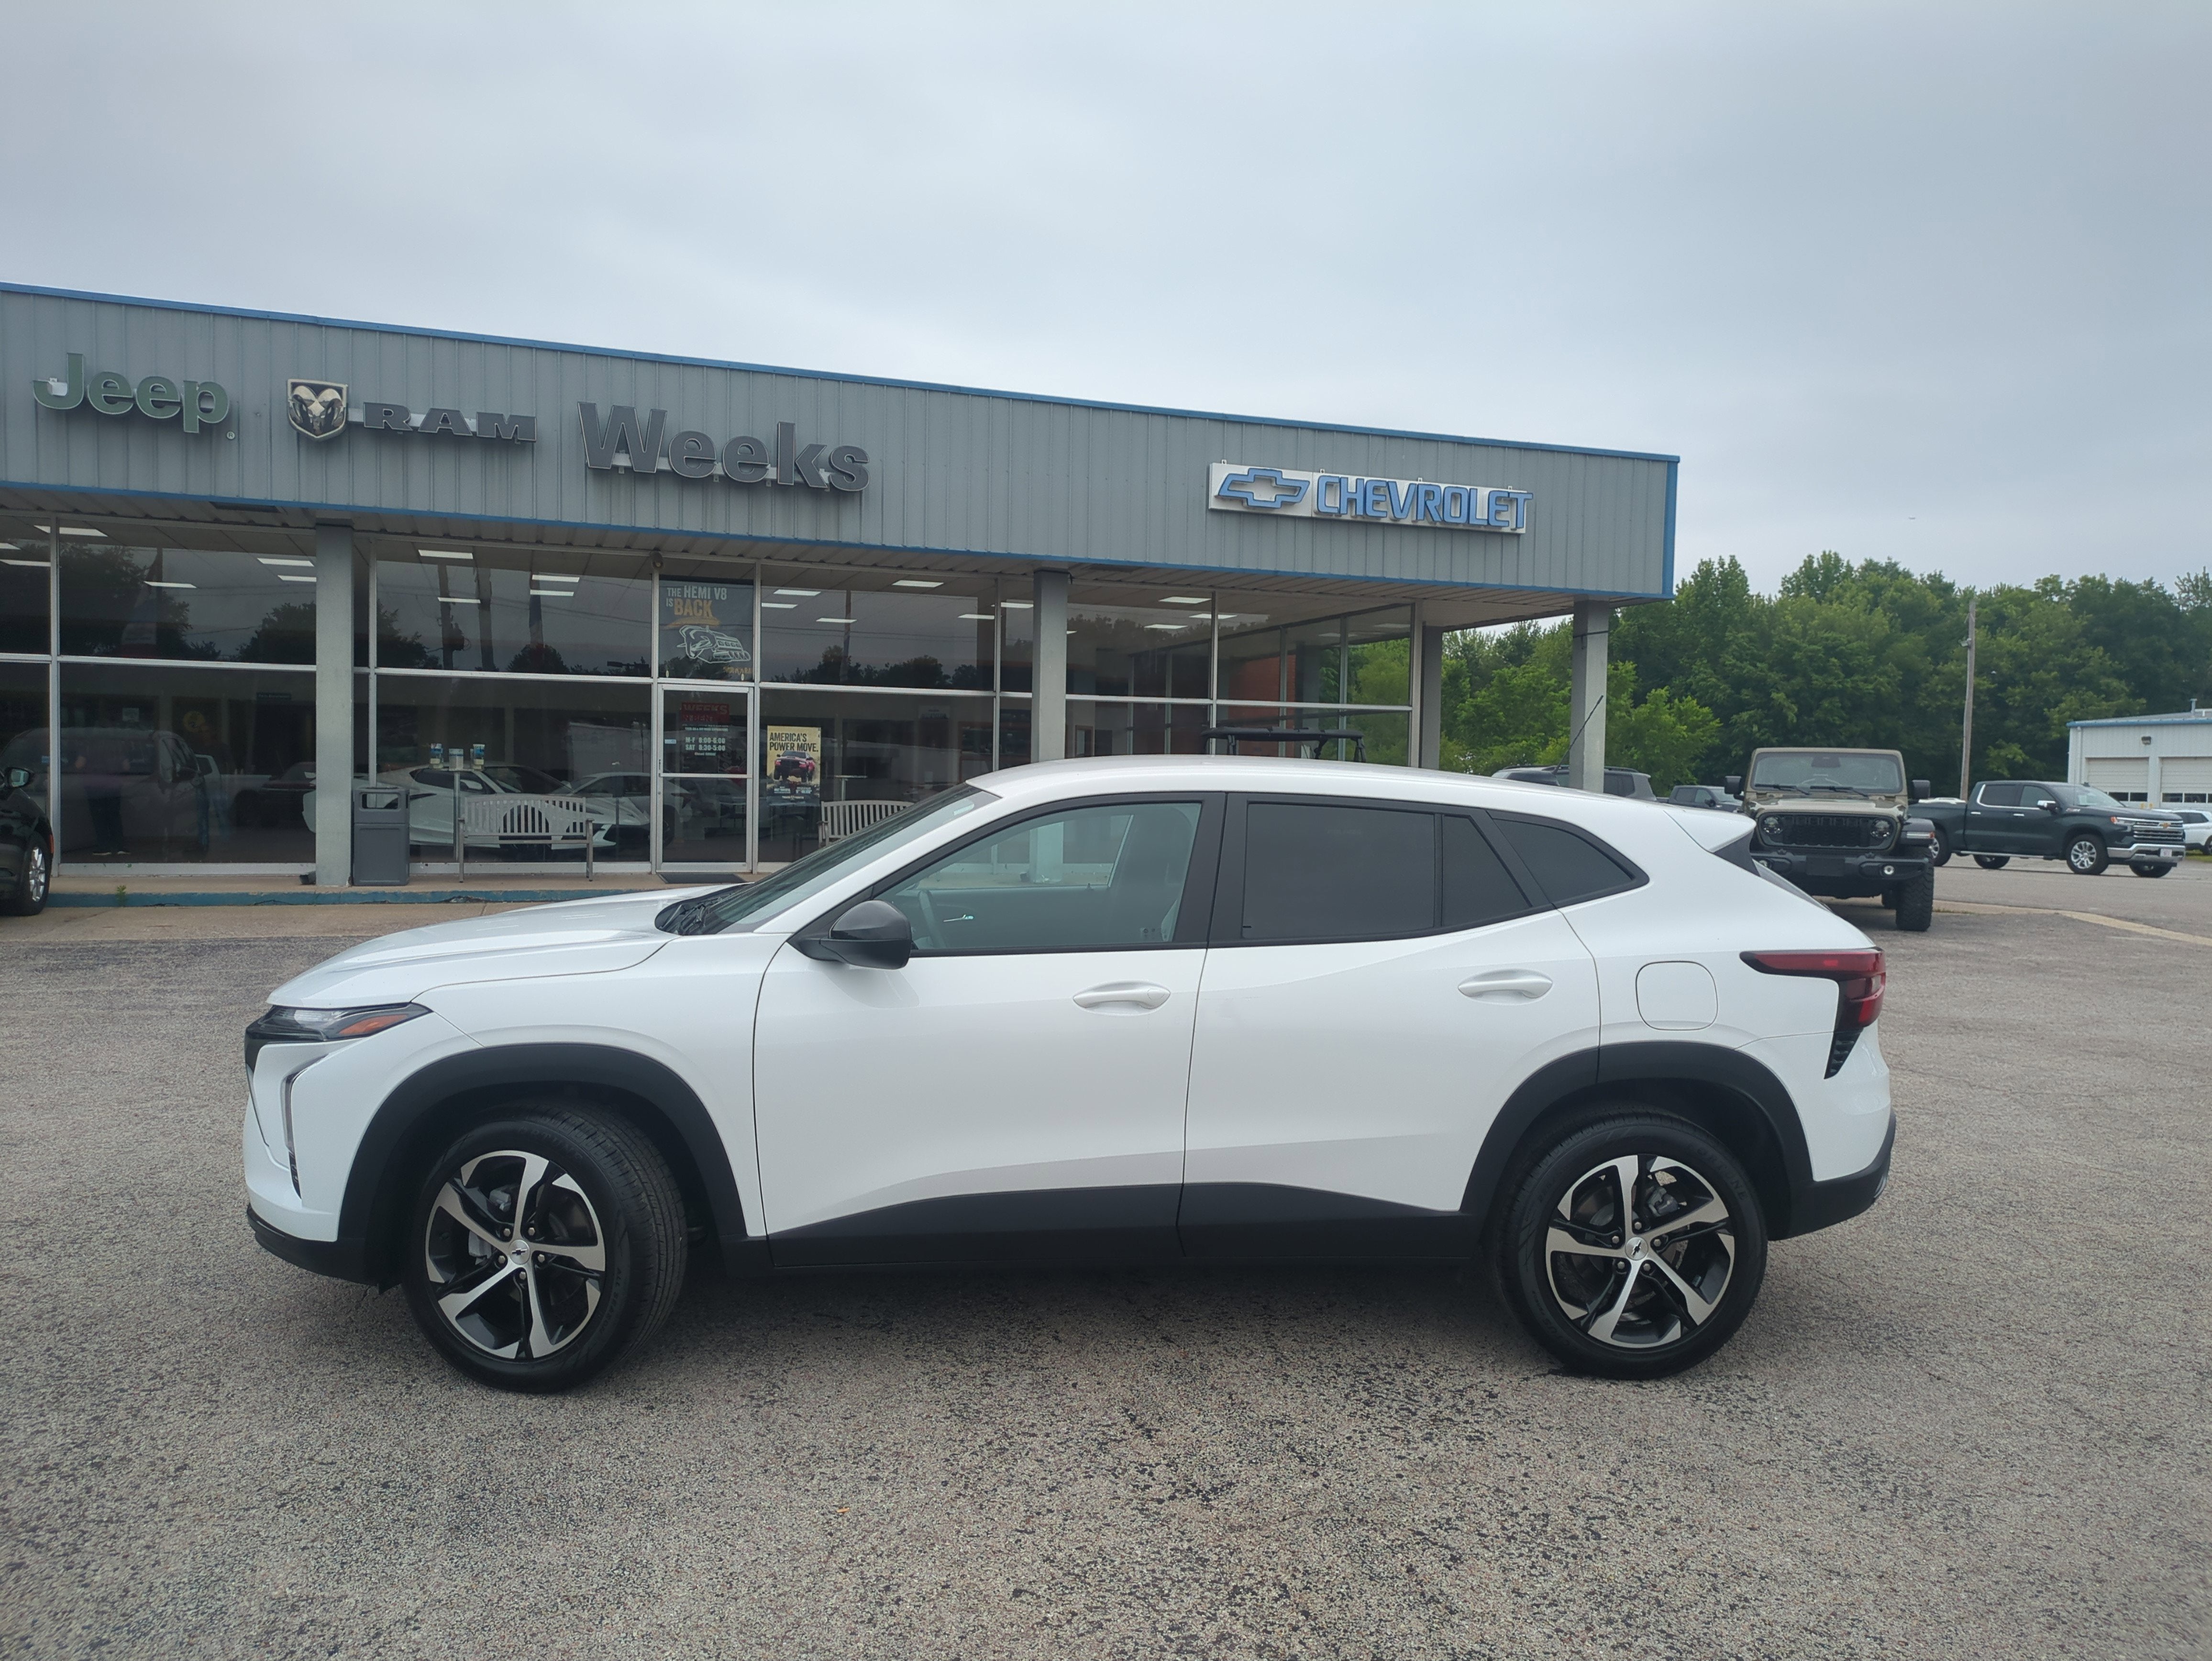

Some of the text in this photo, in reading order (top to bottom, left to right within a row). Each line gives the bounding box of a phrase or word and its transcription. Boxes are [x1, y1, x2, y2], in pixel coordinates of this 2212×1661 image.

[33, 353, 229, 433] Jeep
[364, 402, 537, 443] RAM
[577, 402, 870, 492] Weeks
[1317, 475, 1534, 529] CHEVROLET
[666, 598, 713, 617] IS BACK
[667, 585, 727, 600] THE HEMI V8
[769, 732, 807, 742] AMERICA'S
[769, 742, 818, 752] POWER MOVE.
